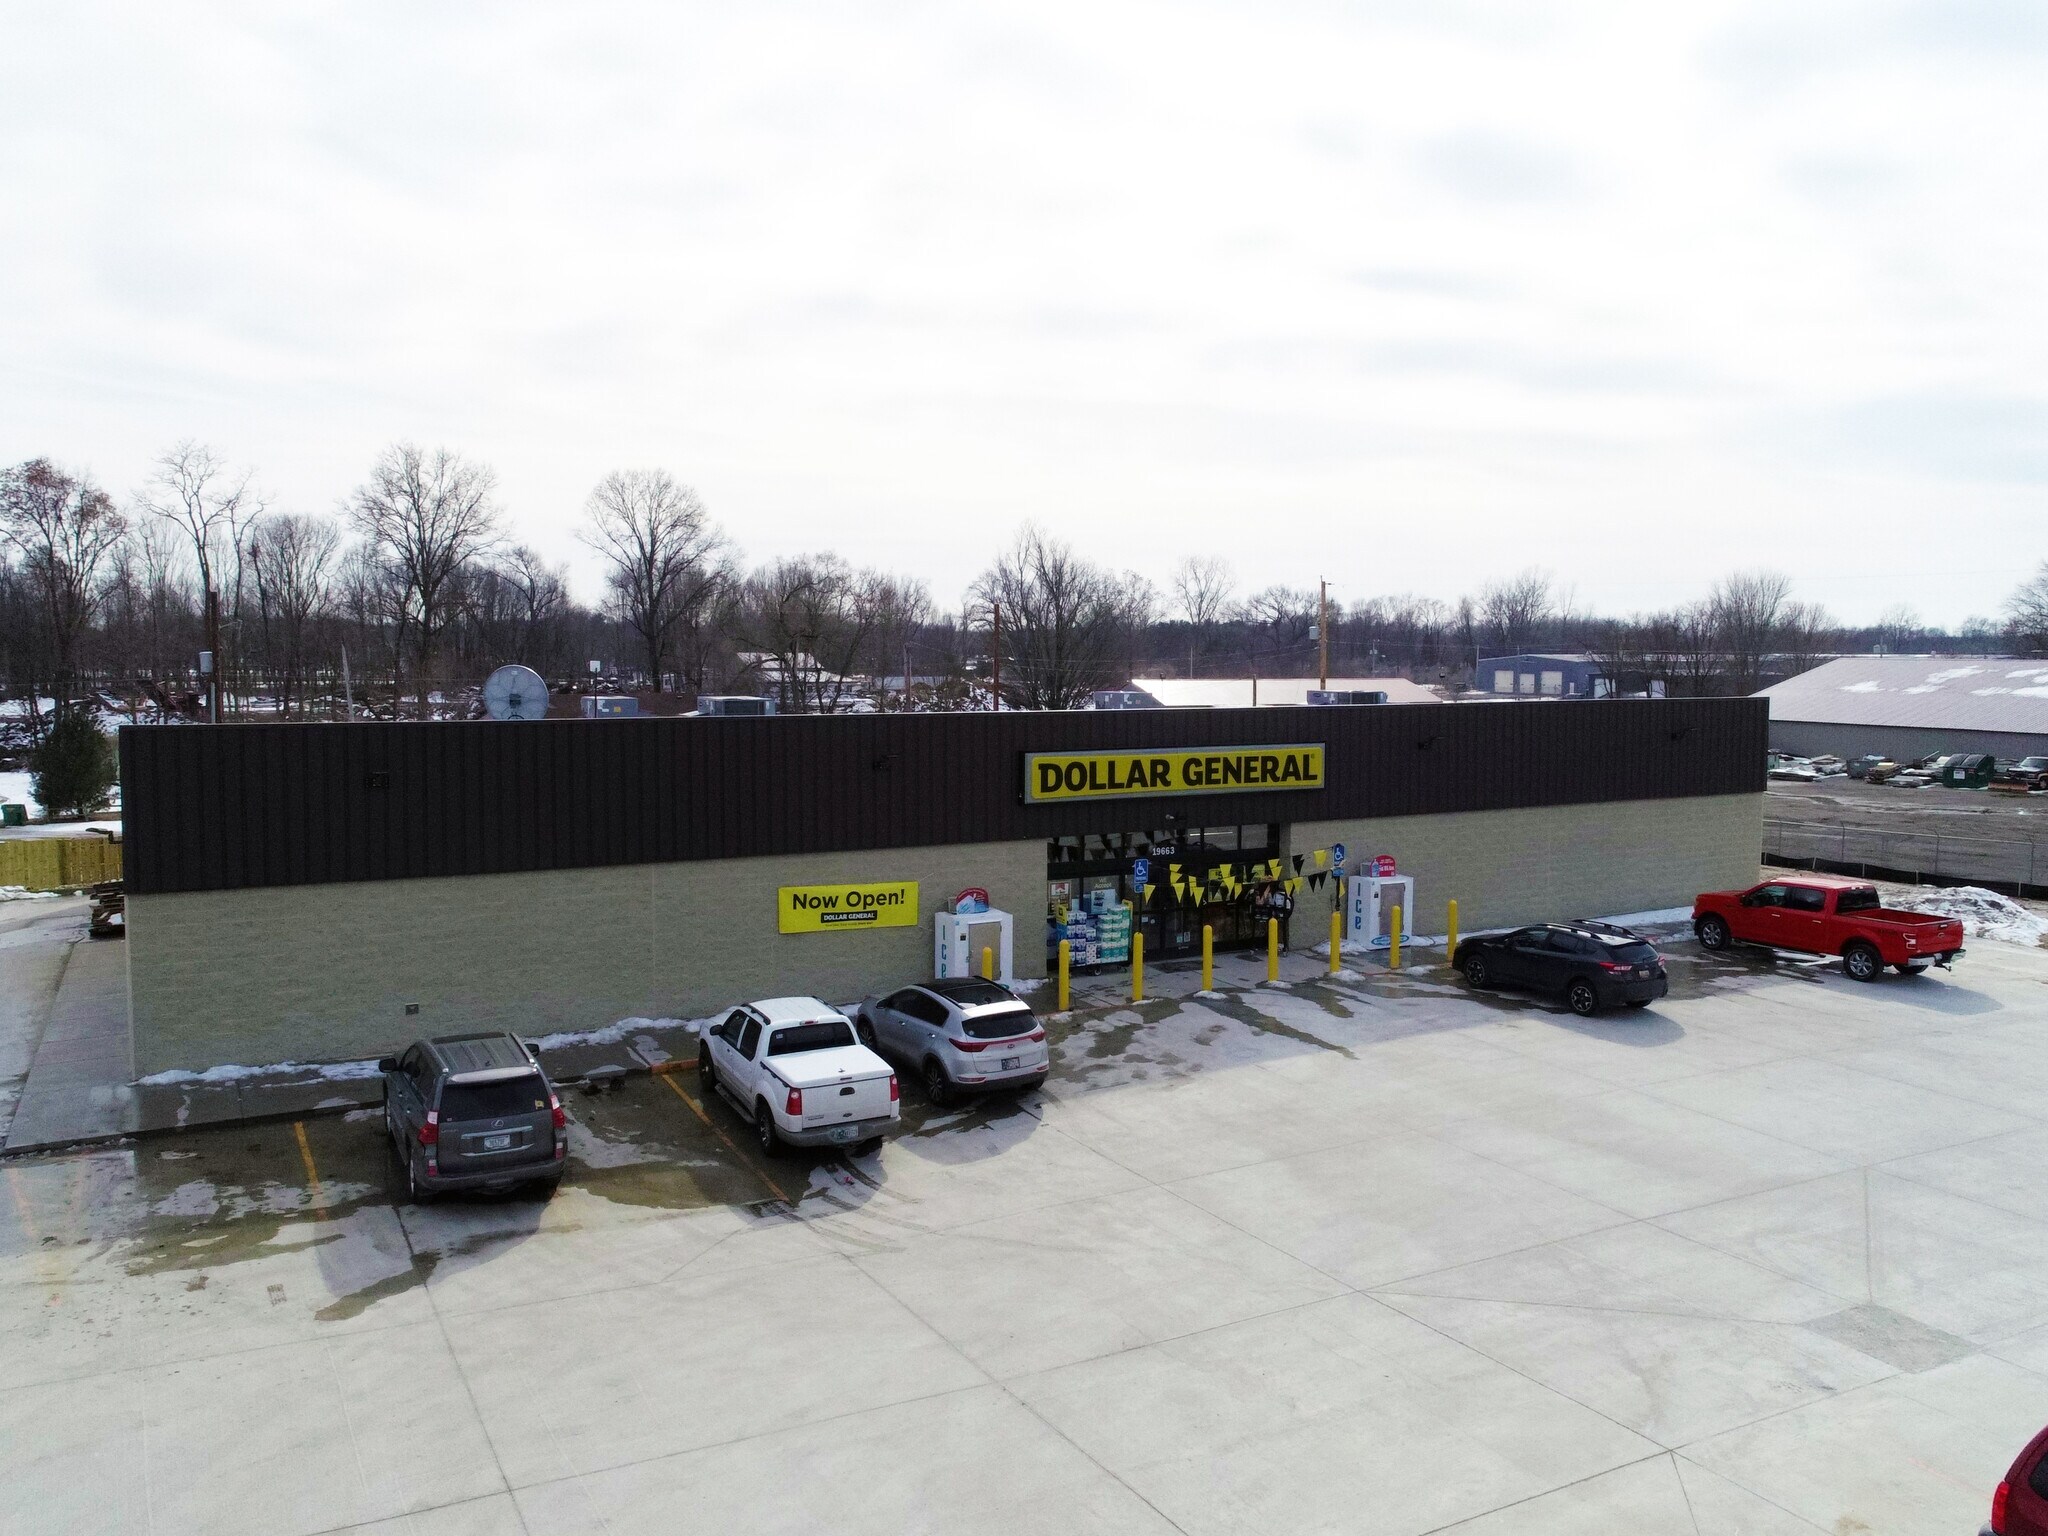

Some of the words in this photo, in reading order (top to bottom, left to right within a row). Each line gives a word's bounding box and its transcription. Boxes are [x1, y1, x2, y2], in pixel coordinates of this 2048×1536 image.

[1038, 759, 1171, 793] DOLLAR
[1182, 754, 1318, 787] GENERAL
[1152, 846, 1175, 856] 19663
[792, 893, 839, 910] Now
[846, 888, 905, 910] Open!
[849, 912, 876, 920] GENERAL
